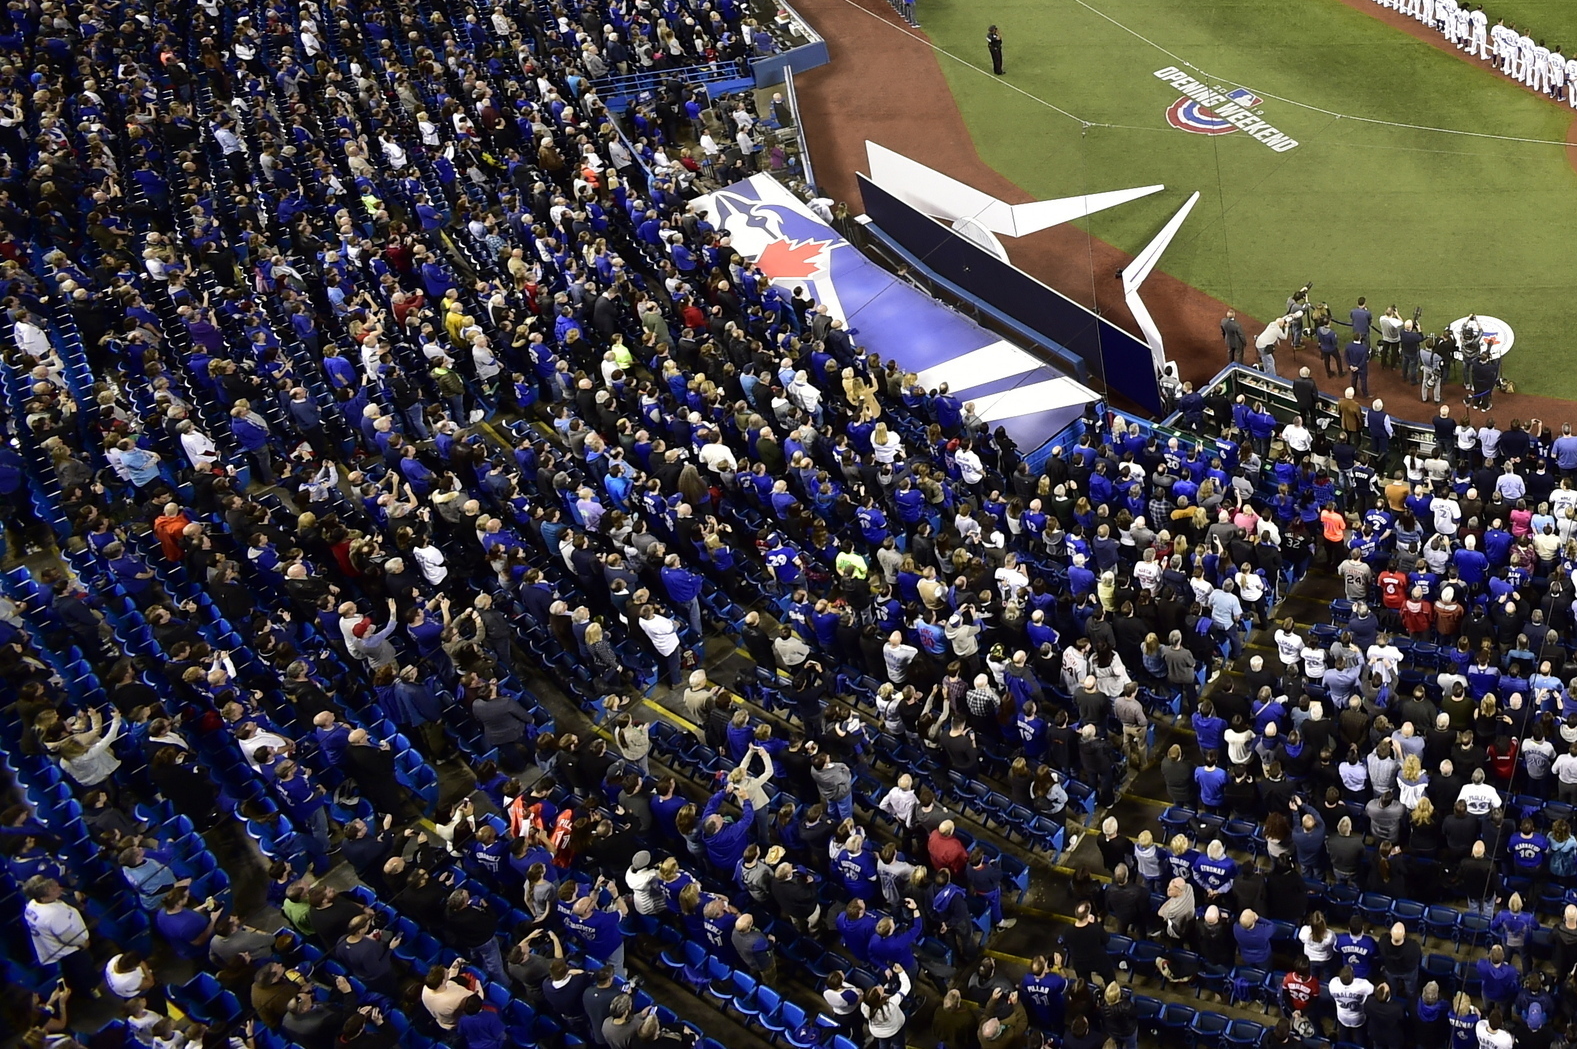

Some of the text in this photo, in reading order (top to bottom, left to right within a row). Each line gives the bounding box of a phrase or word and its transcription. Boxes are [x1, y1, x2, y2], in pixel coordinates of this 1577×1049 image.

[1212, 84, 1265, 116] 20 19
[1152, 66, 1300, 153] OPENING WEEKEND
[1166, 459, 1180, 470] 20
[1440, 508, 1448, 519] 2
[1372, 521, 1381, 531] 2
[1286, 538, 1301, 549] 32
[768, 554, 787, 567] 29
[1142, 572, 1157, 584] 55
[1346, 574, 1362, 585] 24
[1386, 584, 1396, 594] 6
[555, 830, 571, 850] 11
[1525, 849, 1536, 859] 10
[840, 860, 862, 872] BAUTISTA
[1199, 863, 1226, 876] STROMAN
[1207, 875, 1220, 887] 6
[1340, 945, 1369, 956] STROMAN
[1027, 985, 1050, 995] PILLAR
[1032, 994, 1050, 1006] 11
